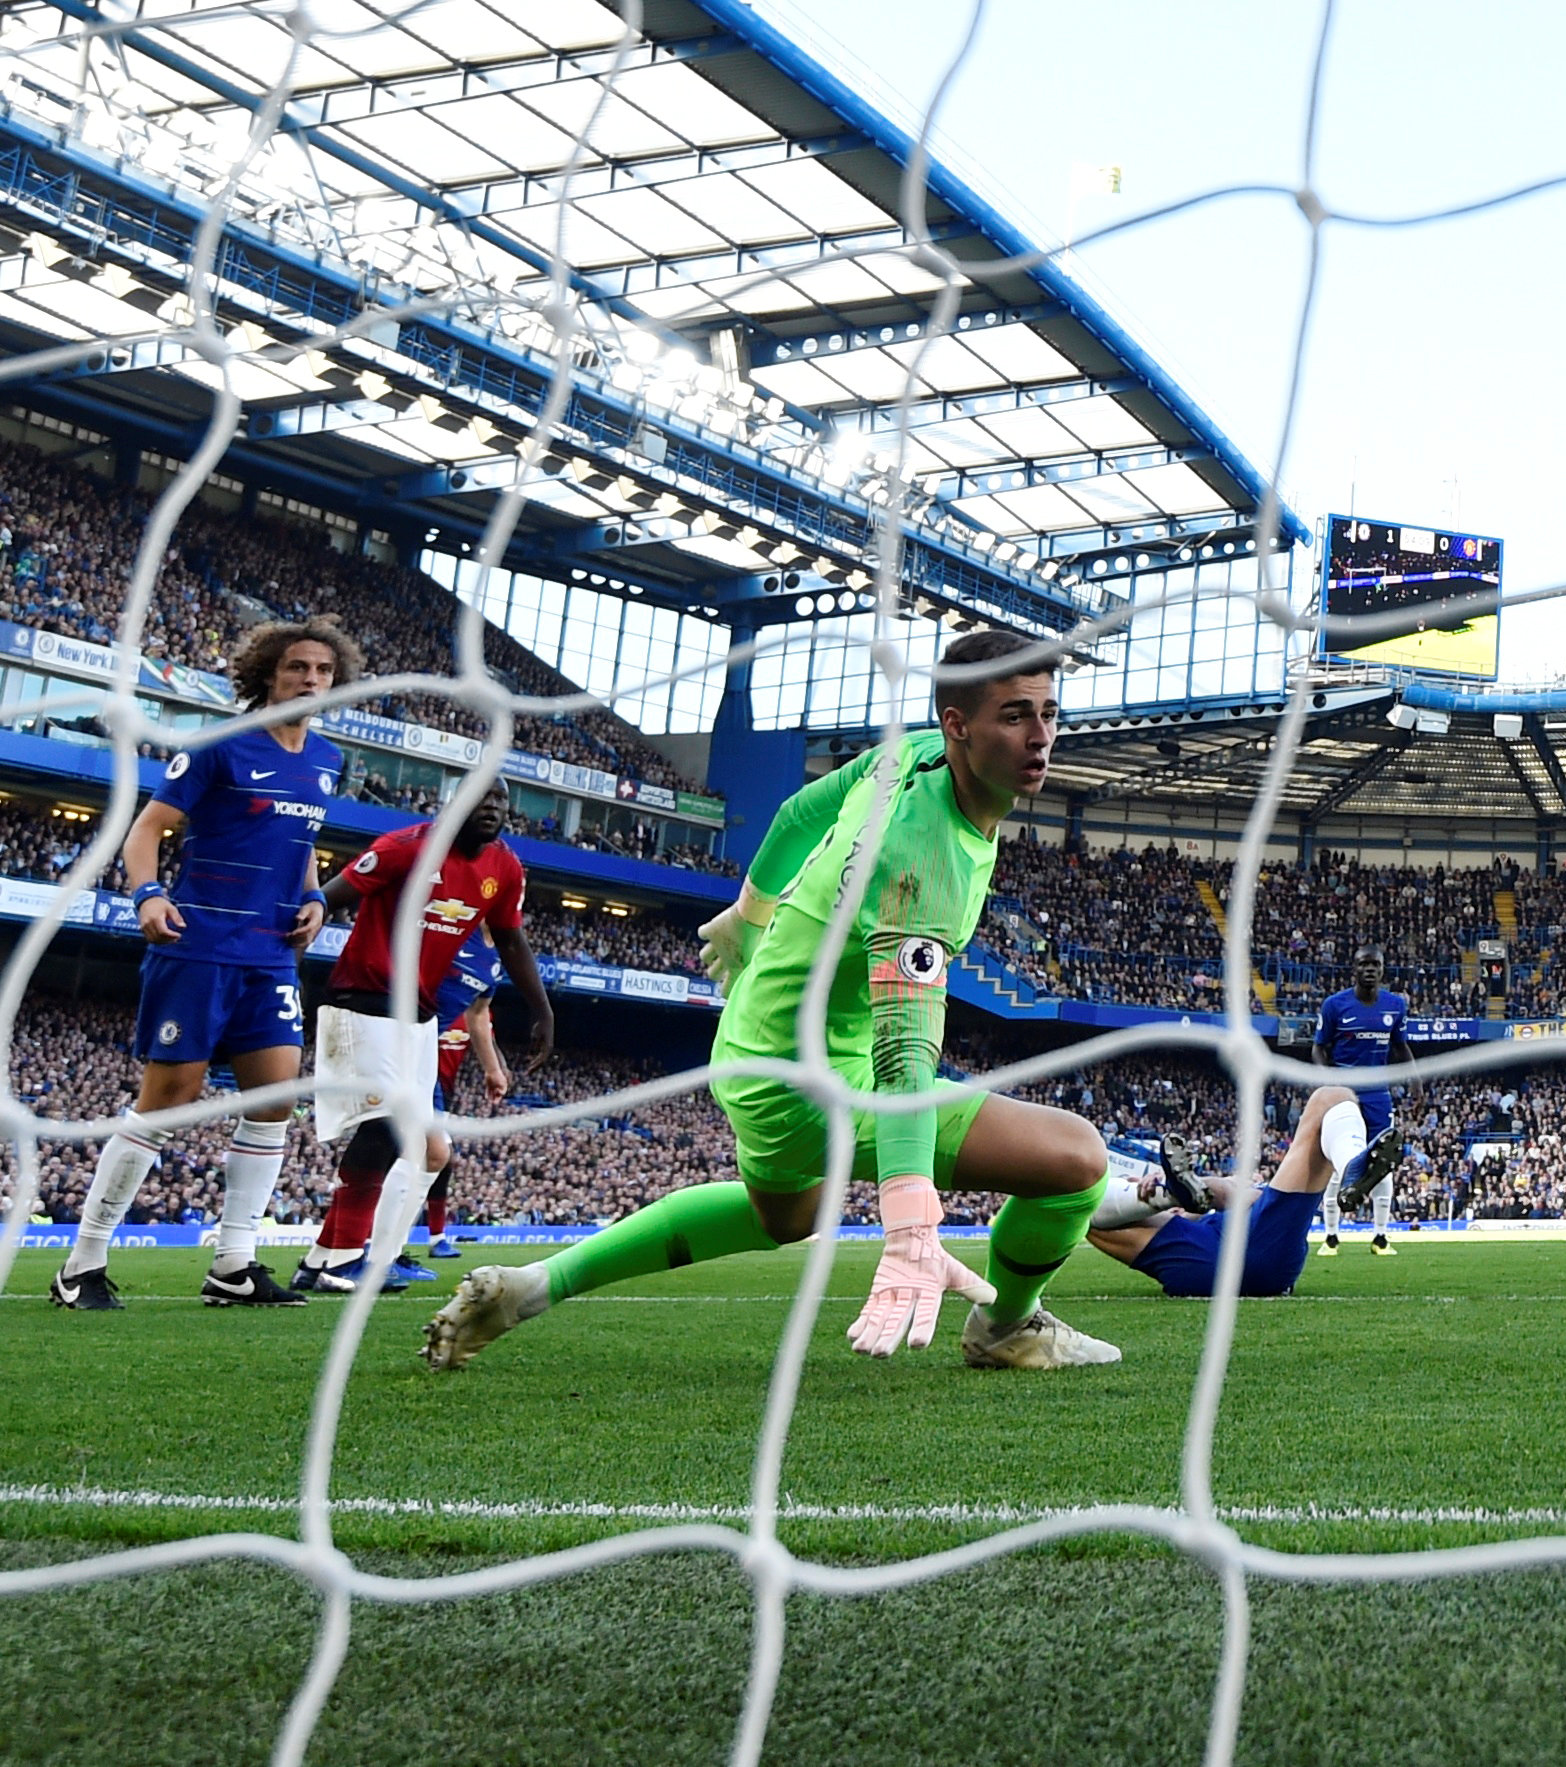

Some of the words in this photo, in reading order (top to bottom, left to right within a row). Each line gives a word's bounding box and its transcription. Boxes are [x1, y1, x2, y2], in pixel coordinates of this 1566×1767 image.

[1387, 529, 1394, 543] 1
[1440, 537, 1449, 550] 0
[57, 642, 82, 662] New
[83, 648, 109, 669] York
[345, 709, 405, 731] MELBOURNE
[342, 724, 403, 747] CHELSEA
[273, 800, 327, 820] YOKOHAM
[625, 979, 673, 994] HASTINGS
[1538, 1023, 1564, 1038] THE
